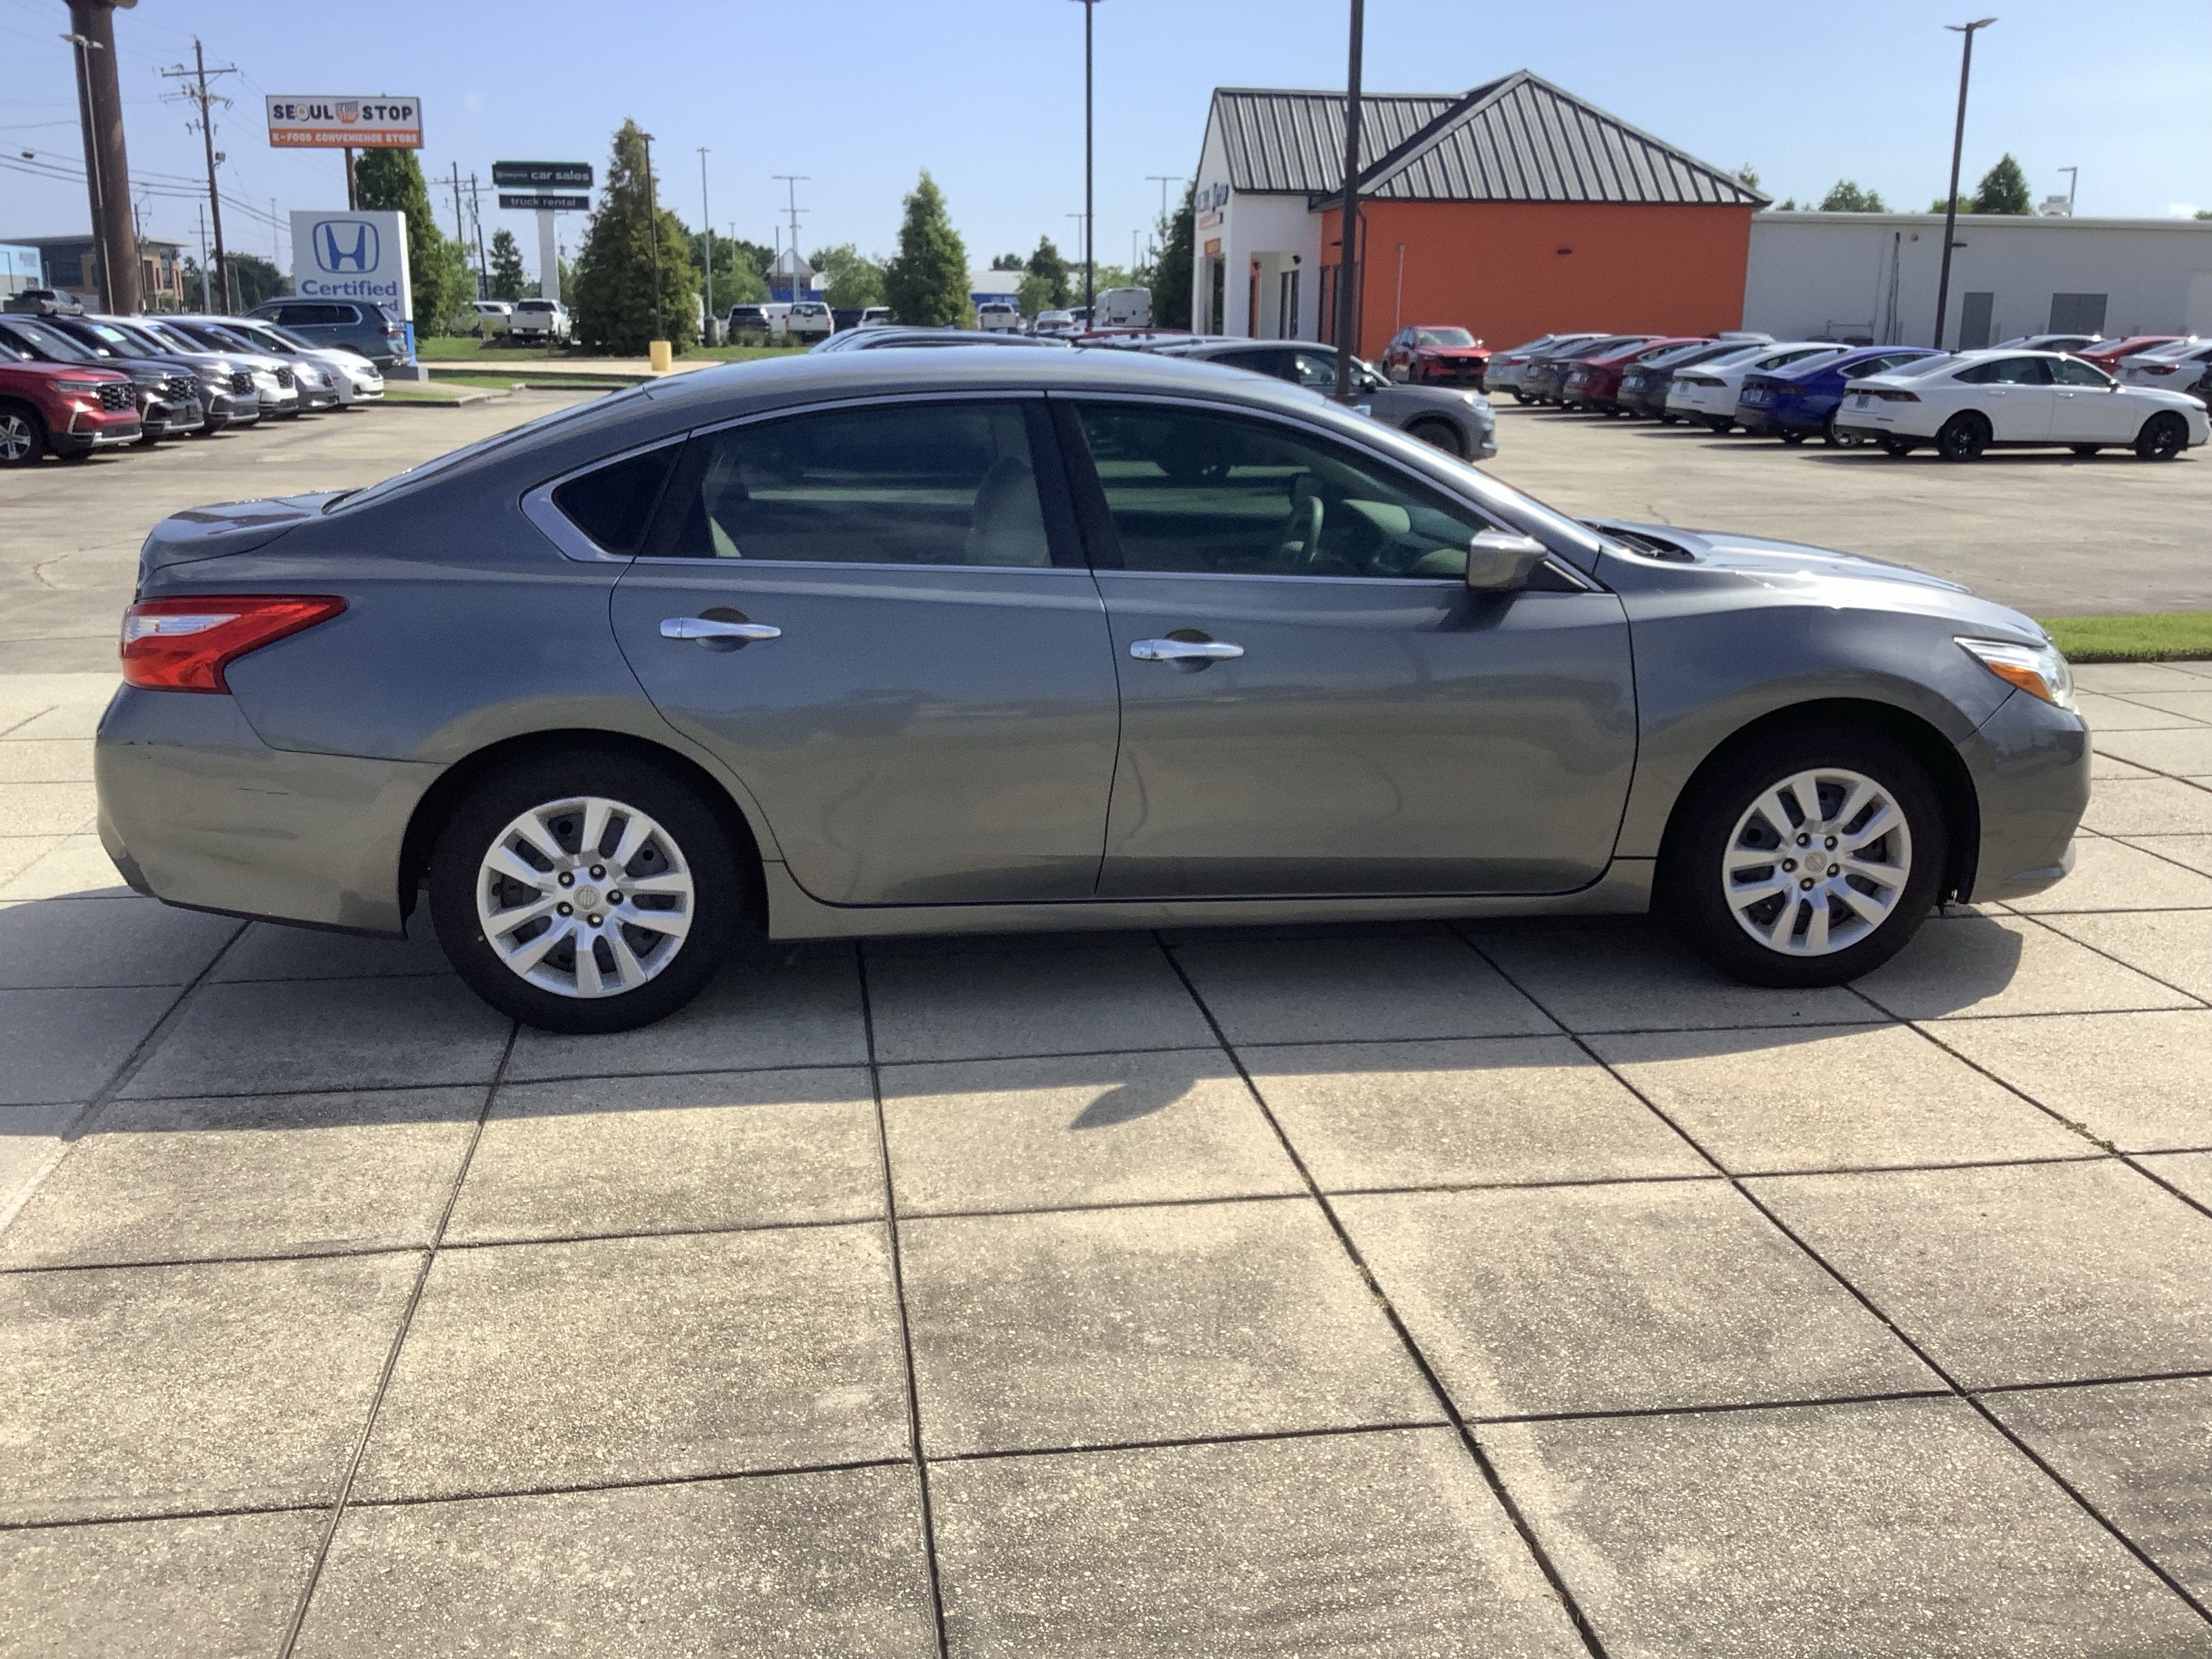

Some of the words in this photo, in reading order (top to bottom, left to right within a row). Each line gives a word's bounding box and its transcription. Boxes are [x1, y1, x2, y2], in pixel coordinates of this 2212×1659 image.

[273, 104, 334, 121] SEOUL
[362, 105, 413, 121] STOP
[315, 132, 383, 143] CONVENIENCE
[386, 134, 418, 144] STORE
[531, 171, 553, 180] car
[555, 169, 590, 181] sales
[510, 197, 539, 206] truck
[543, 197, 576, 207] rental
[301, 279, 398, 296] Certified
